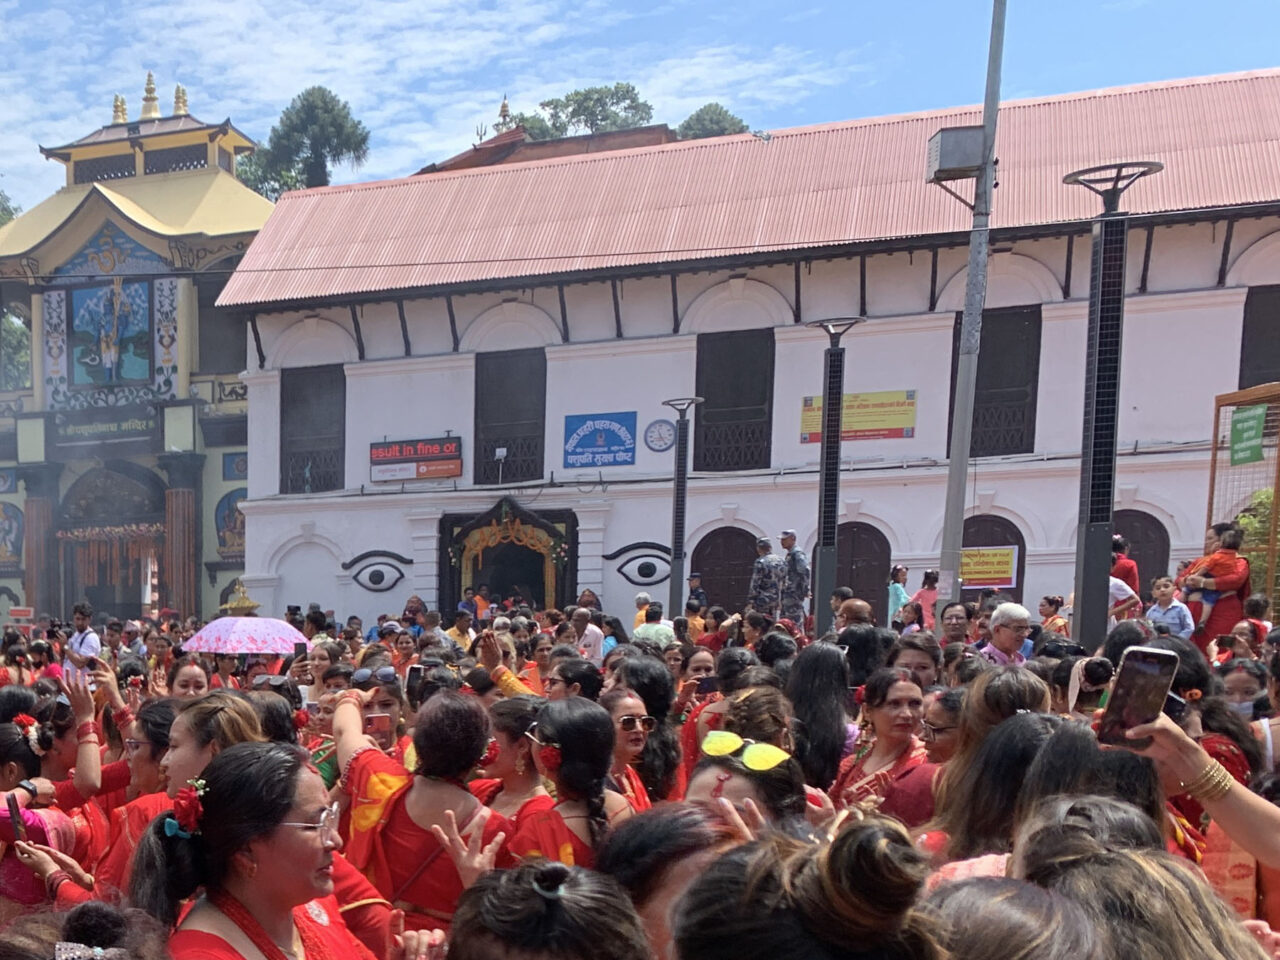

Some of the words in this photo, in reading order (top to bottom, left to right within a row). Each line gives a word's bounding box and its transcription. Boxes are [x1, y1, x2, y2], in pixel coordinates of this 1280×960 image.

[402, 443, 414, 456] in
[417, 442, 441, 455] fine
[443, 443, 457, 453] or
